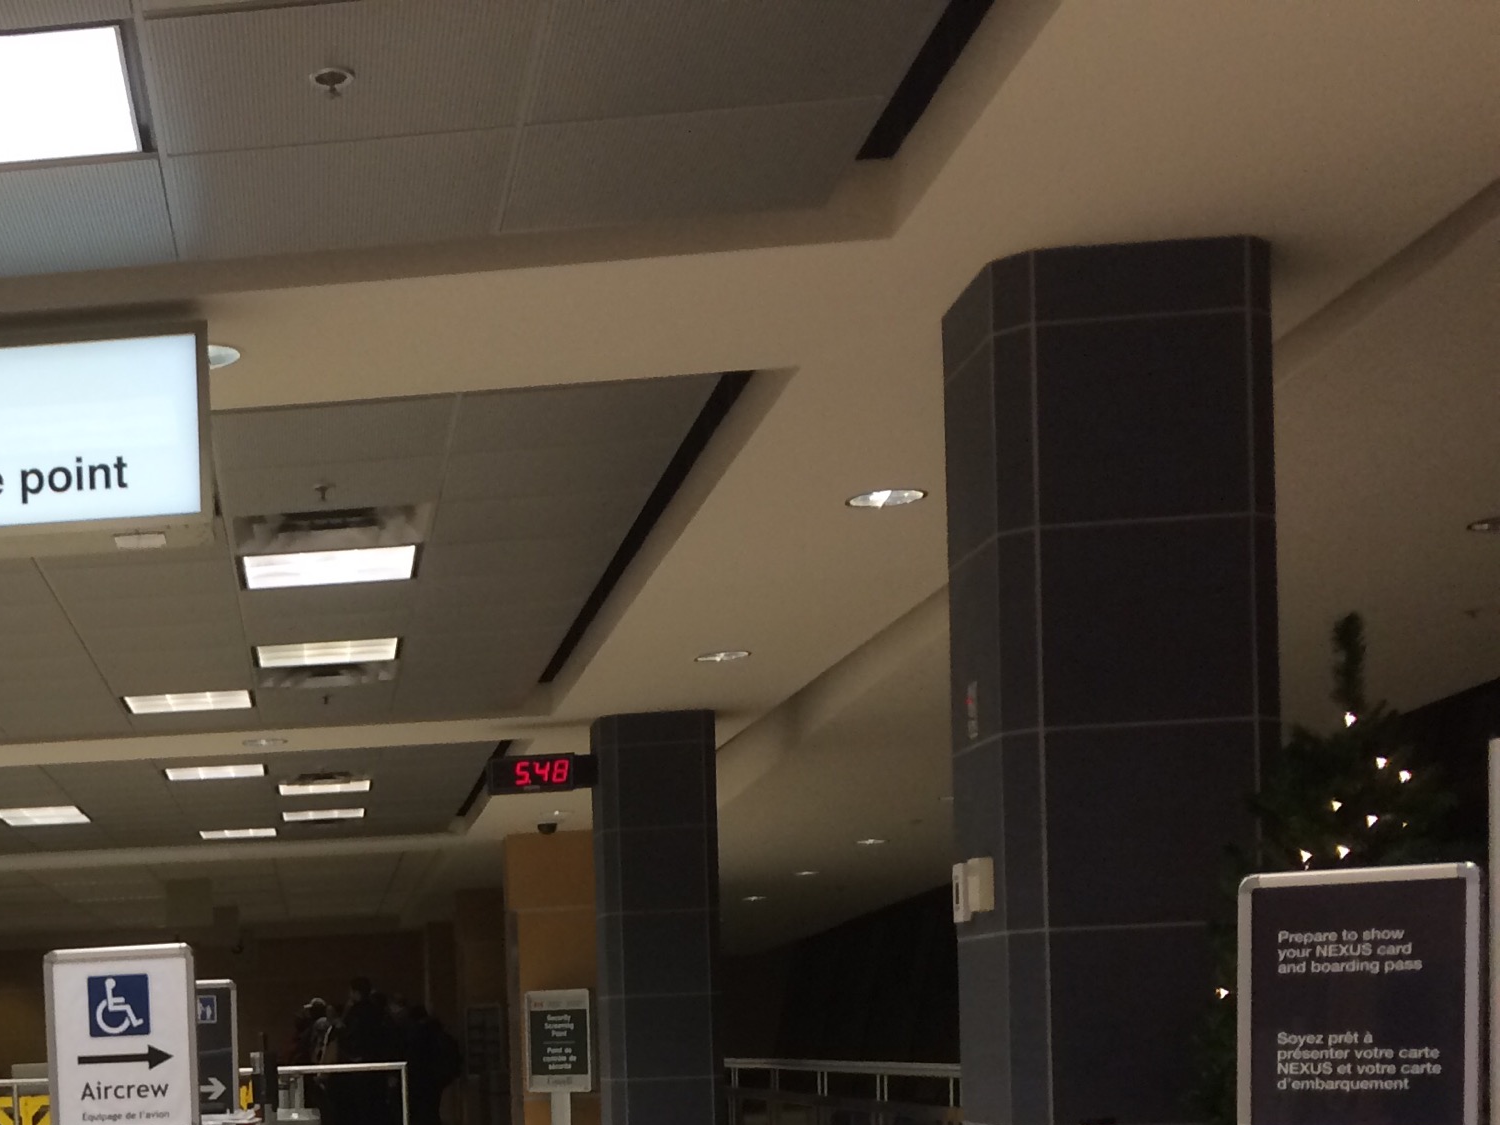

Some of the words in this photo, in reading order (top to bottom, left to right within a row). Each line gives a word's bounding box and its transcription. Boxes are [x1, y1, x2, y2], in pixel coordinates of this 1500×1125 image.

[21, 457, 127, 504] point
[1278, 931, 1338, 945] Prepare
[1342, 930, 1358, 941] to
[1362, 928, 1405, 941] show
[1277, 948, 1312, 961] your
[1315, 943, 1372, 957] NEXUS
[1376, 942, 1412, 955] card
[1277, 961, 1306, 974] and
[1310, 959, 1380, 974] boarding
[1384, 958, 1422, 973] pass
[1277, 1032, 1324, 1047] Soyez
[1328, 1031, 1359, 1045] prêt
[1364, 1030, 1373, 1043] à
[1277, 1048, 1351, 1061] présenter
[1354, 1048, 1395, 1059] votre
[1398, 1046, 1441, 1059] carte
[1277, 1062, 1333, 1075] NEXUS
[1336, 1063, 1352, 1075] et
[1357, 1063, 1397, 1075] votre
[1400, 1062, 1442, 1075] carte
[81, 1081, 169, 1101] Aircrew
[1277, 1077, 1410, 1092] d'embarquement
[125, 1112, 136, 1120] de
